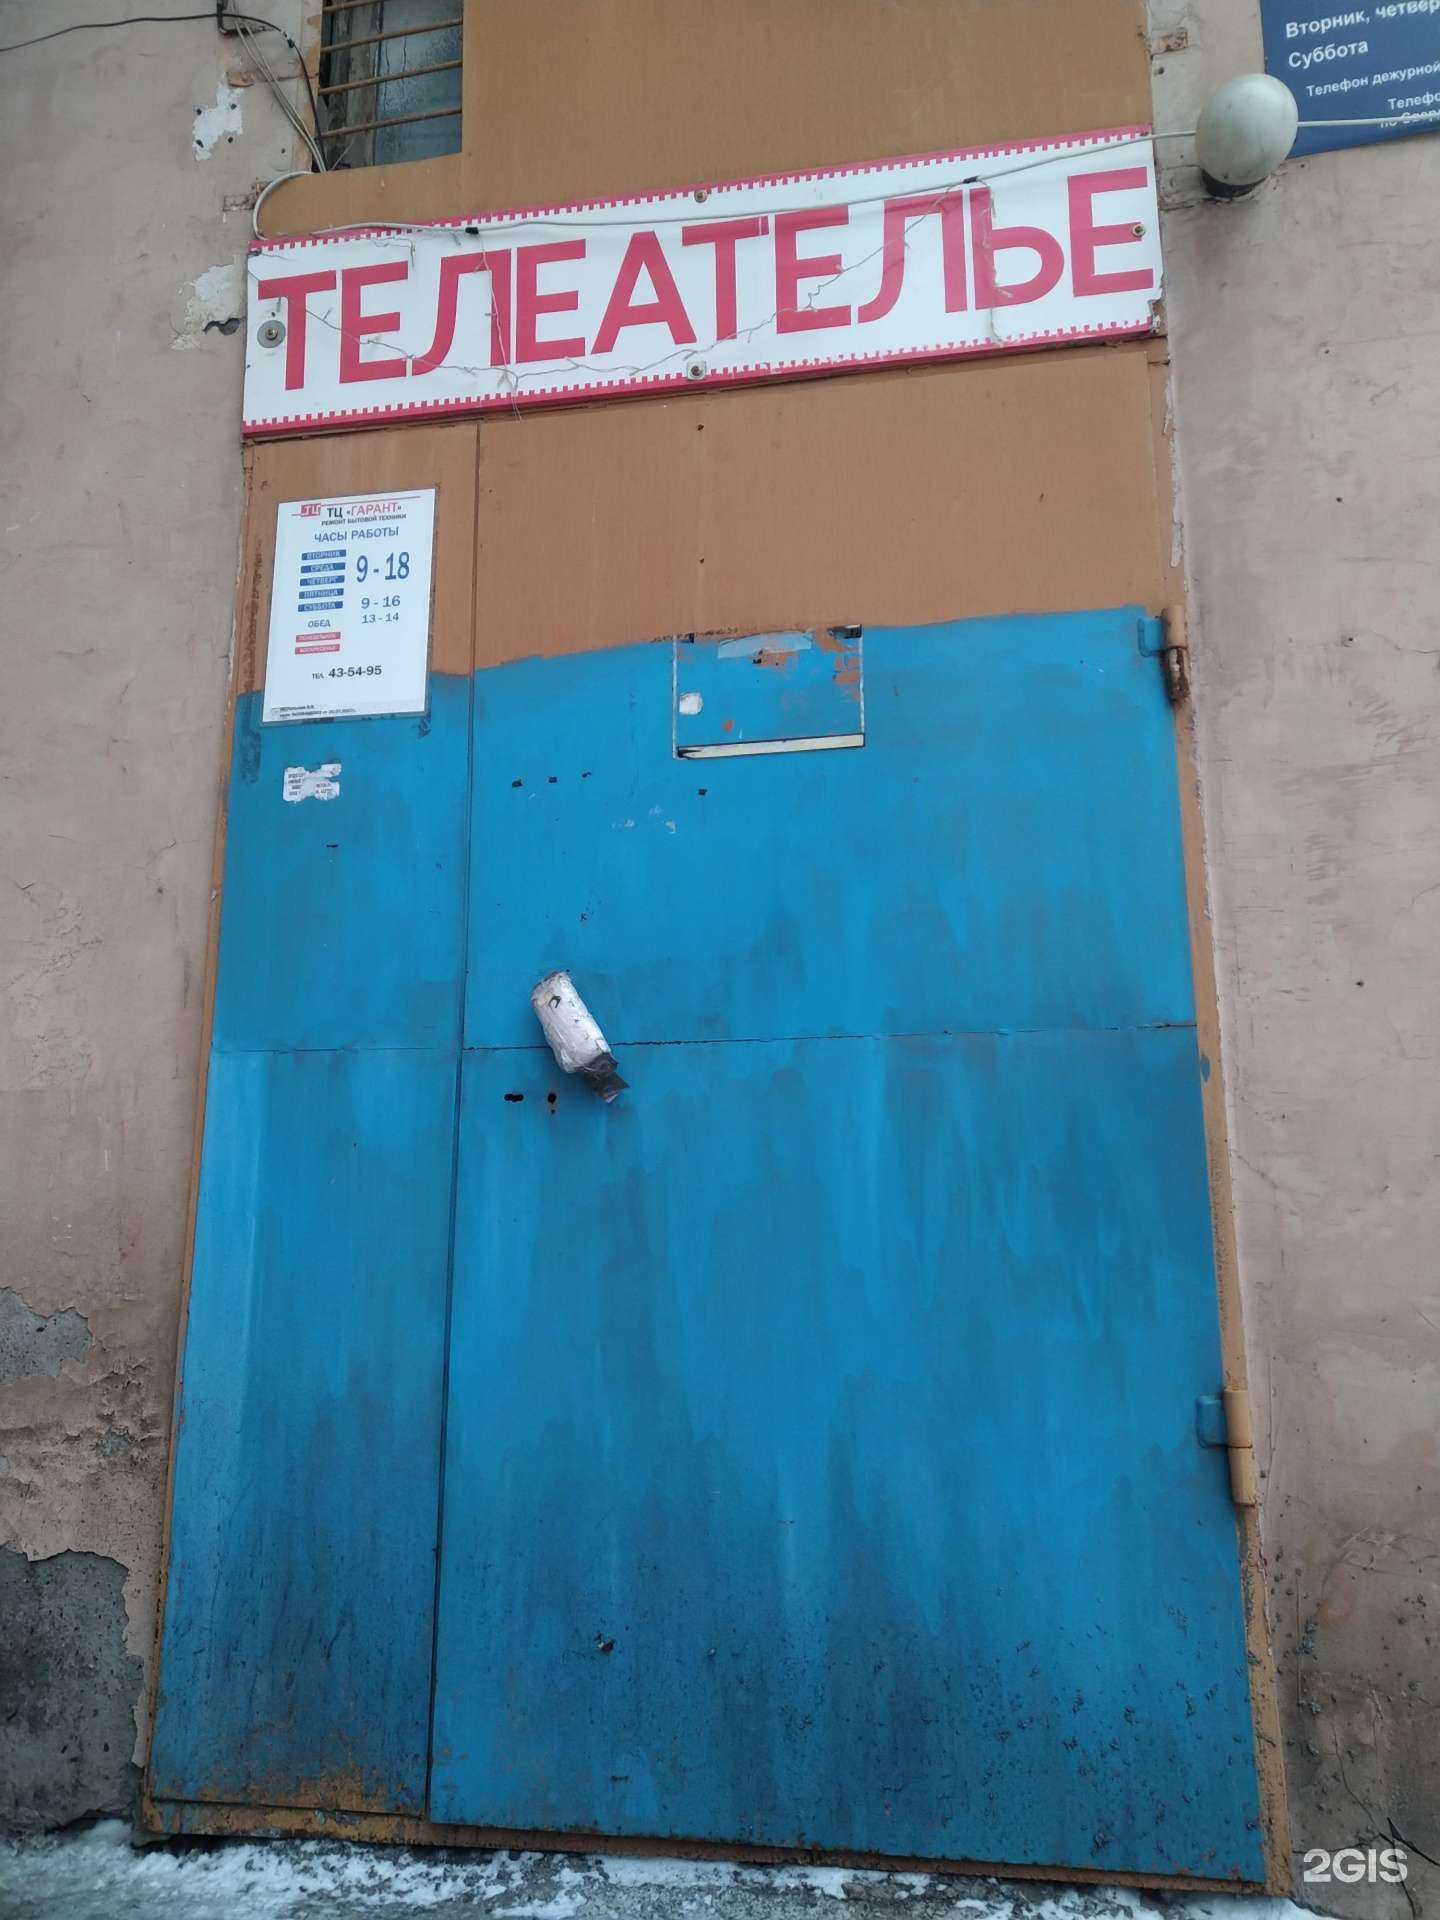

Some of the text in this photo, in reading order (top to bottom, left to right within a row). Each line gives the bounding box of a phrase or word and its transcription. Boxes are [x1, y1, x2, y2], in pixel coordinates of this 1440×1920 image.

[1285, 9, 1370, 39] Вторник,
[1288, 40, 1369, 69] Суббота
[1306, 76, 1369, 97] Телефон
[257, 166, 1154, 391] ТЕЛЕАТЕЛЬЕ
[327, 507, 343, 518] ТЦ
[314, 526, 399, 543] ЧАСЫ РАБОТЫ
[356, 555, 368, 583] 9
[384, 551, 410, 581] 18
[361, 597, 370, 609] 9
[383, 595, 401, 608] 16
[307, 619, 331, 628] ОБЕД
[361, 614, 376, 624] 13
[385, 612, 399, 622] 14
[328, 665, 382, 678] 43-54-95
